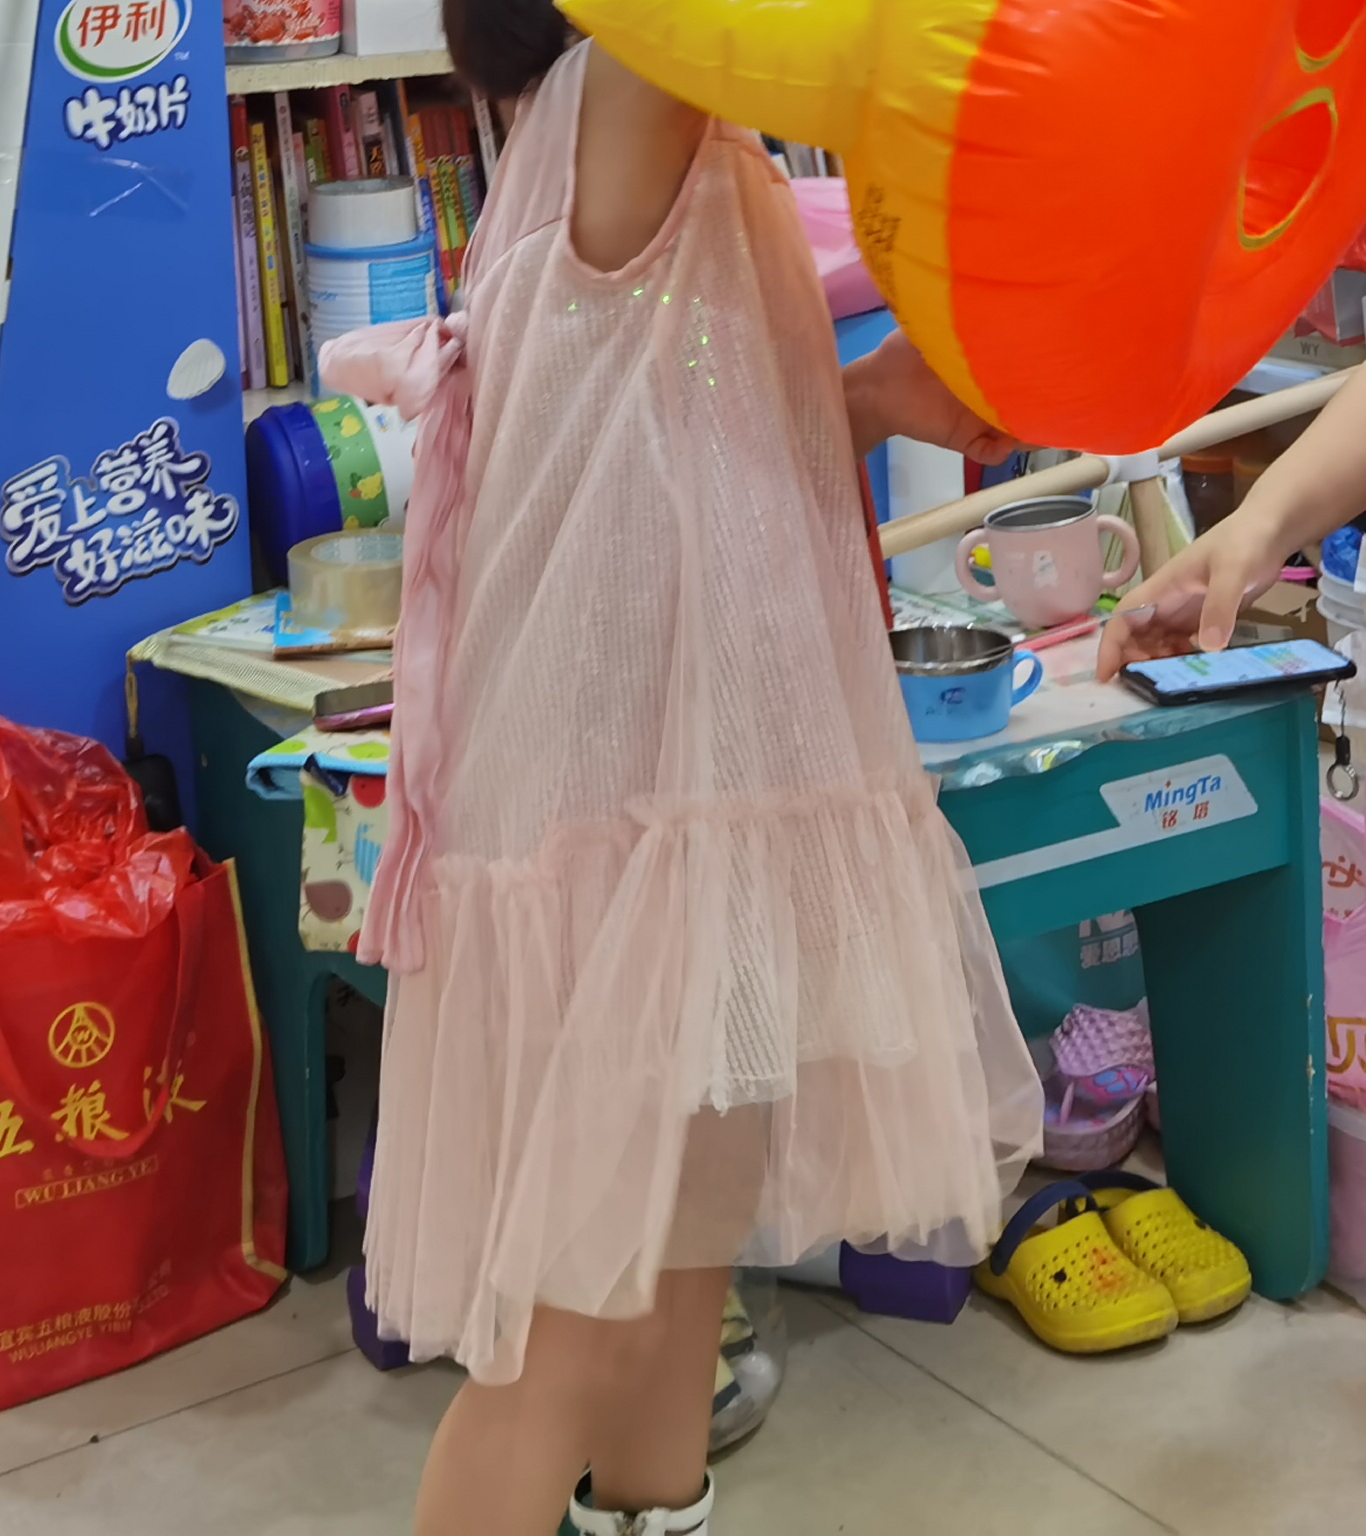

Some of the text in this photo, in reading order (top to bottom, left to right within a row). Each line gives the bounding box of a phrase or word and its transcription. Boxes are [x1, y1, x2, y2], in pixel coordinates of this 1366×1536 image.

[66, 77, 190, 148] 牛奶片
[2, 432, 202, 562] 爱上营养
[63, 488, 237, 592] 好滋味
[1143, 774, 1223, 814] MingTa
[23, 1183, 57, 1206] WU
[62, 1169, 124, 1200] LIANG
